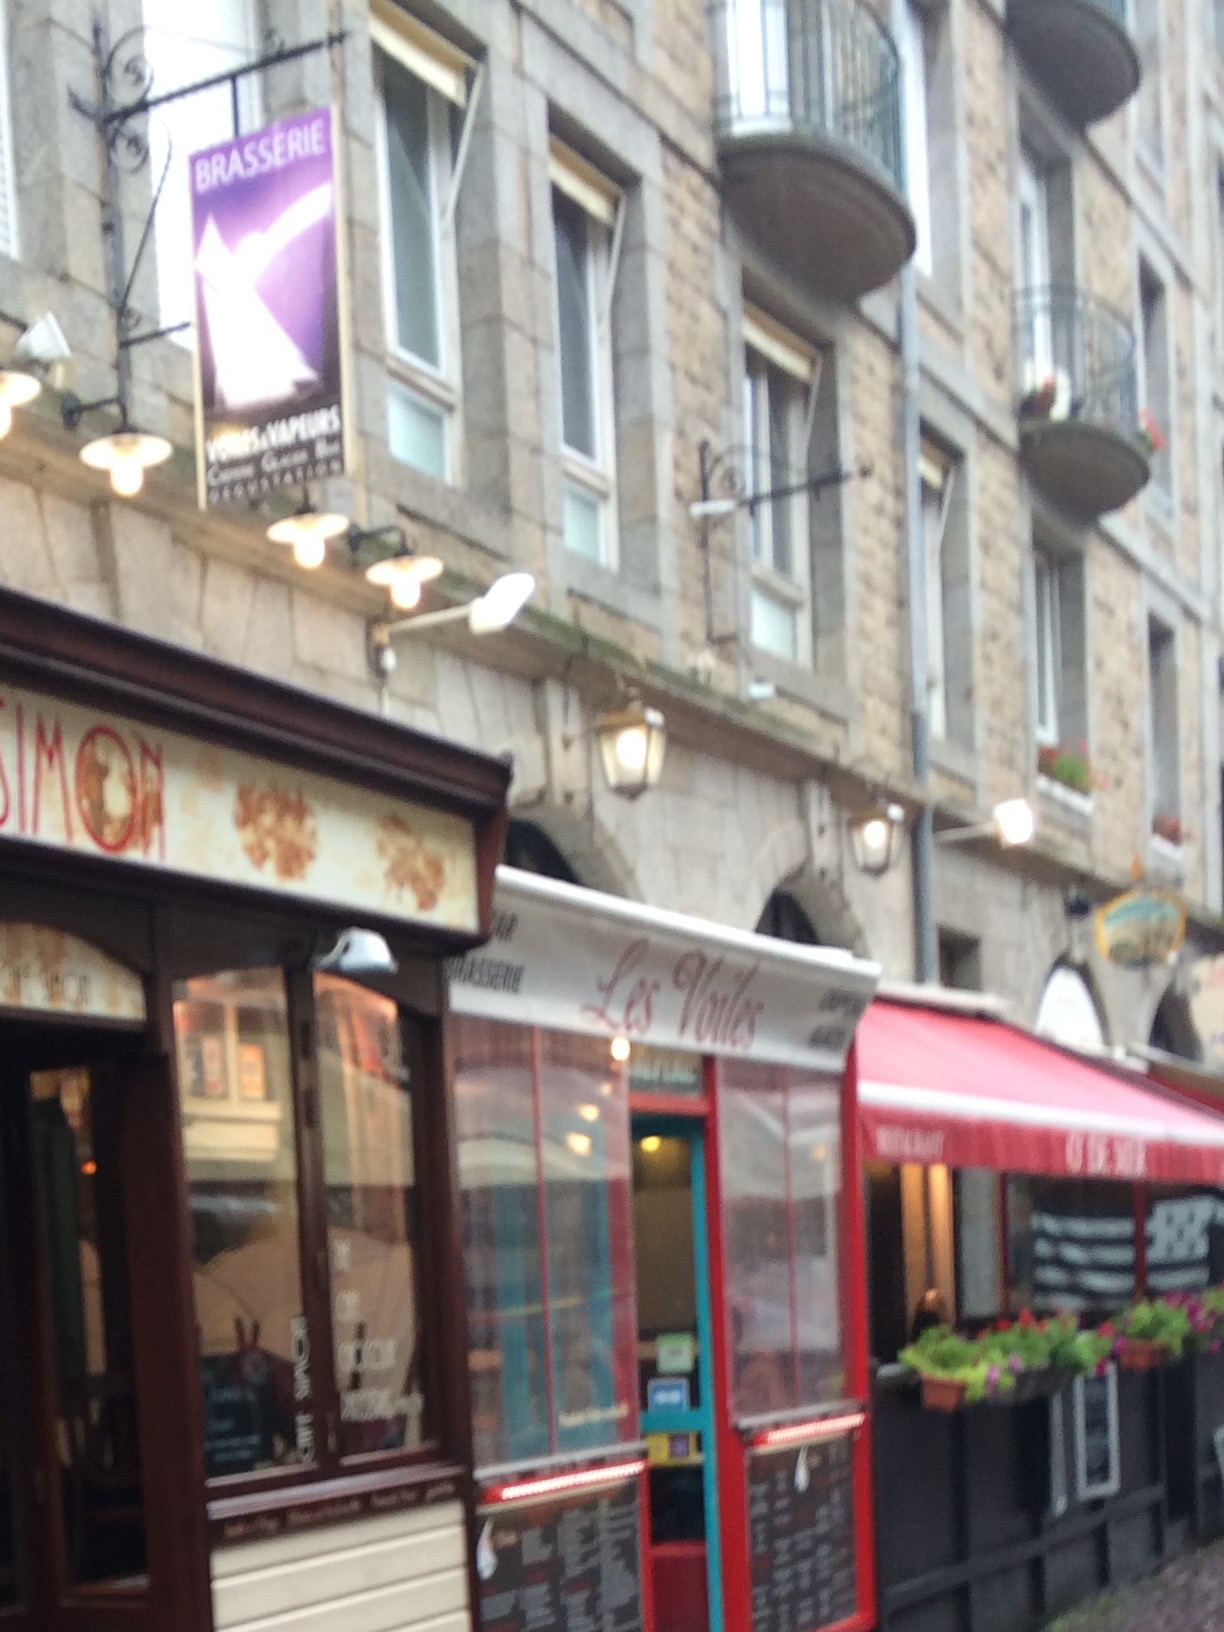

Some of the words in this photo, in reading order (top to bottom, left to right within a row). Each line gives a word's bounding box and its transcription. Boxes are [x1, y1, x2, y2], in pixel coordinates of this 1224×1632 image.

[195, 118, 327, 193] BRASSERIE
[580, 936, 660, 1034] Les
[672, 949, 765, 1051] Voiles
